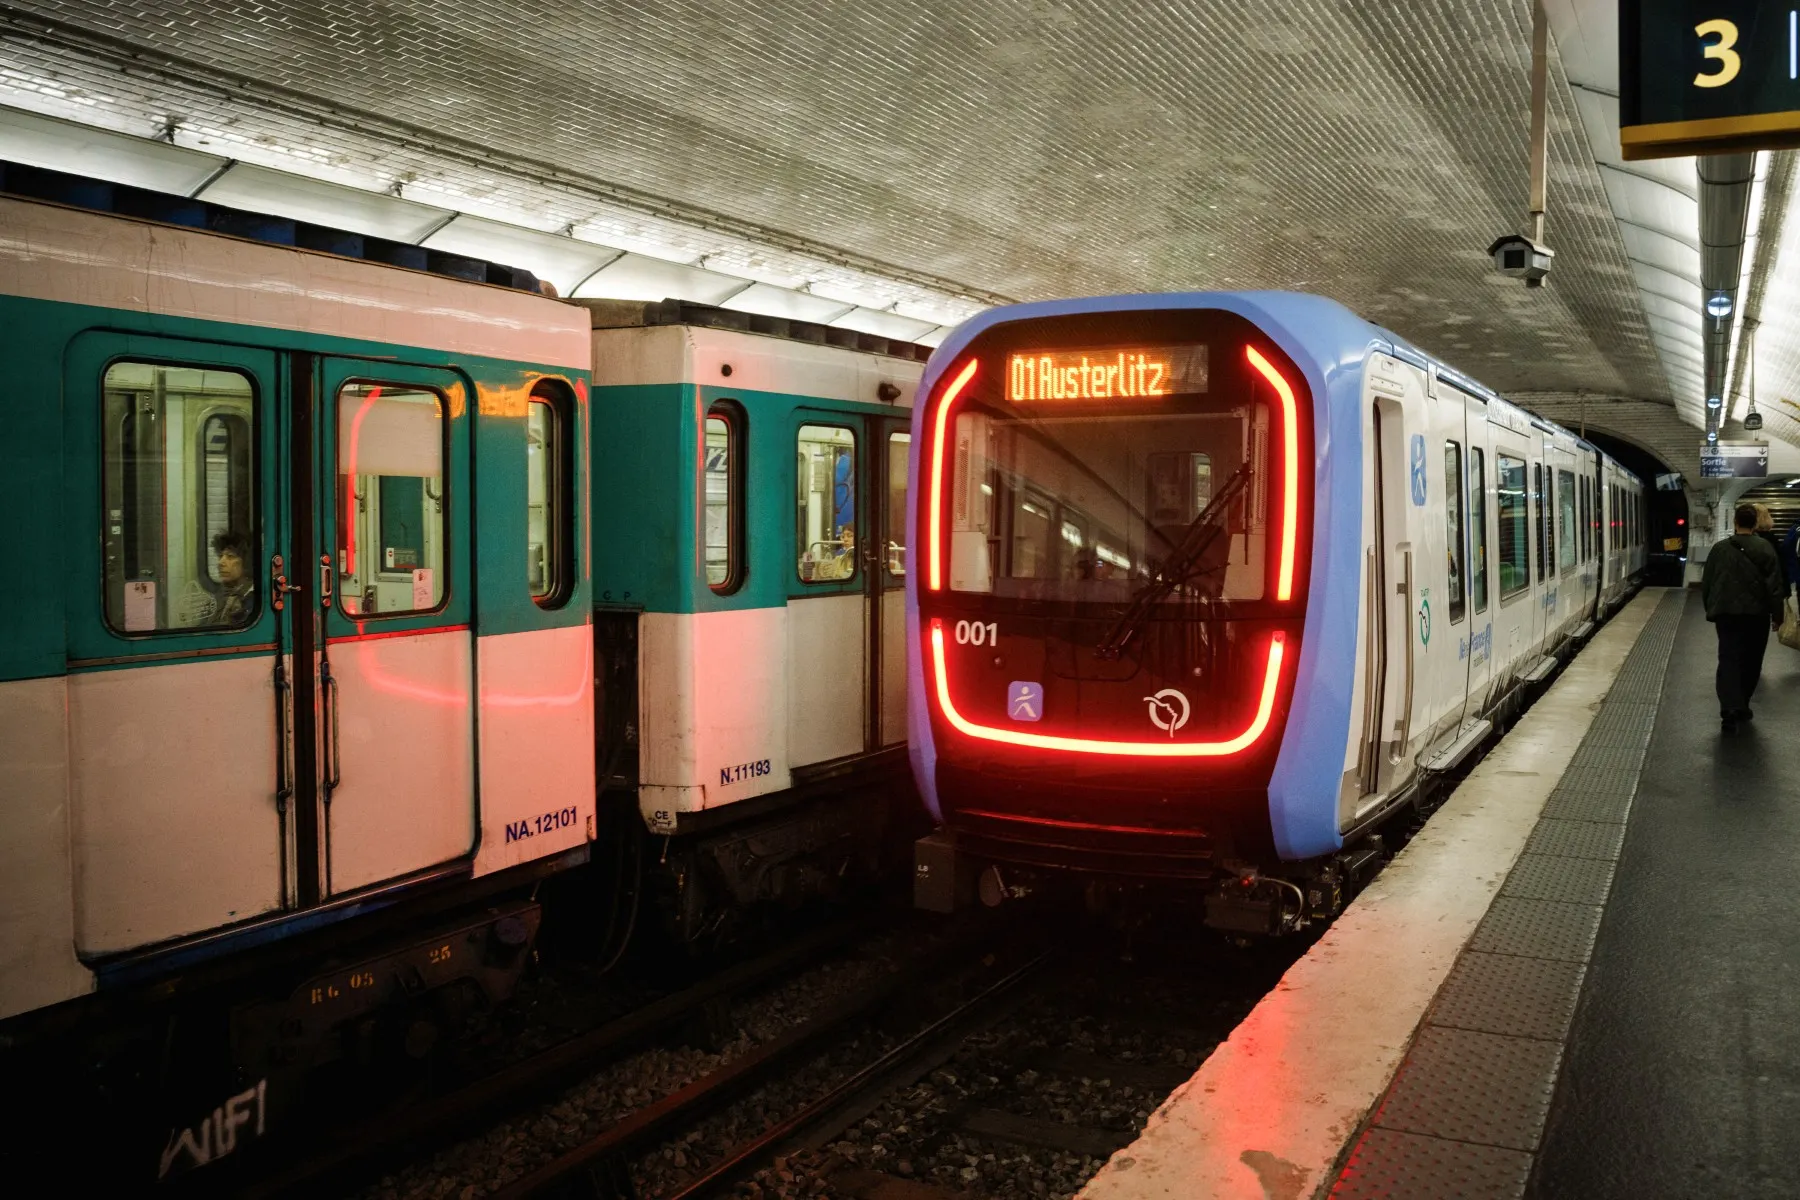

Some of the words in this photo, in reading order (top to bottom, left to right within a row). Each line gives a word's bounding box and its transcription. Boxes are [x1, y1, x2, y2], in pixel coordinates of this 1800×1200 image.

[1693, 18, 1741, 88] 3
[1039, 353, 1164, 400] Austerlitz
[1701, 458, 1726, 466] Sortie
[955, 620, 998, 647] 001
[721, 760, 770, 785] N.11193
[505, 806, 577, 843] NA.12101
[655, 810, 669, 819] CE
